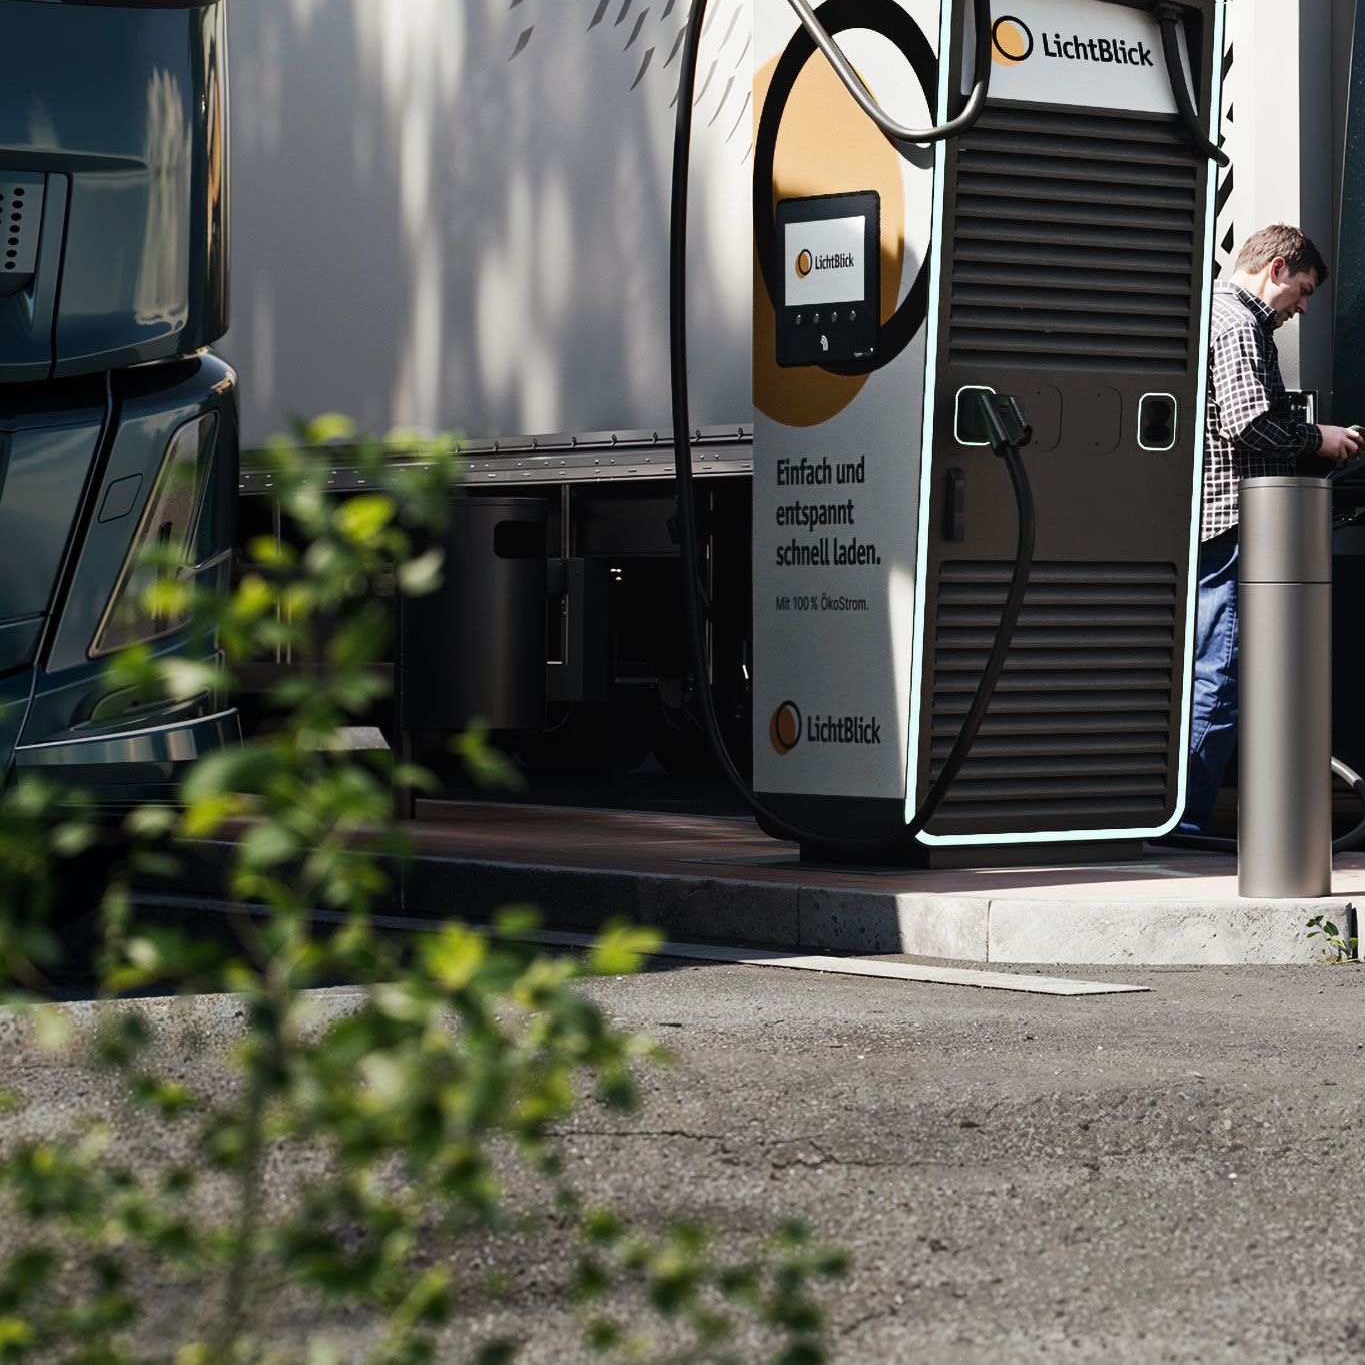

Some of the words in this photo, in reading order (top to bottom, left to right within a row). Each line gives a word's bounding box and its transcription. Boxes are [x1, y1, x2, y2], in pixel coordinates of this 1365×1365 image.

[1042, 32, 1154, 67] LichtBlick
[814, 252, 854, 270] LichtBlick
[776, 456, 832, 486] Einfach
[836, 455, 865, 485] und
[775, 499, 855, 533] entspannt
[775, 537, 831, 567] schnell
[833, 537, 881, 566] laden.
[775, 595, 791, 611] Mit
[806, 714, 881, 745] LichtBlick
